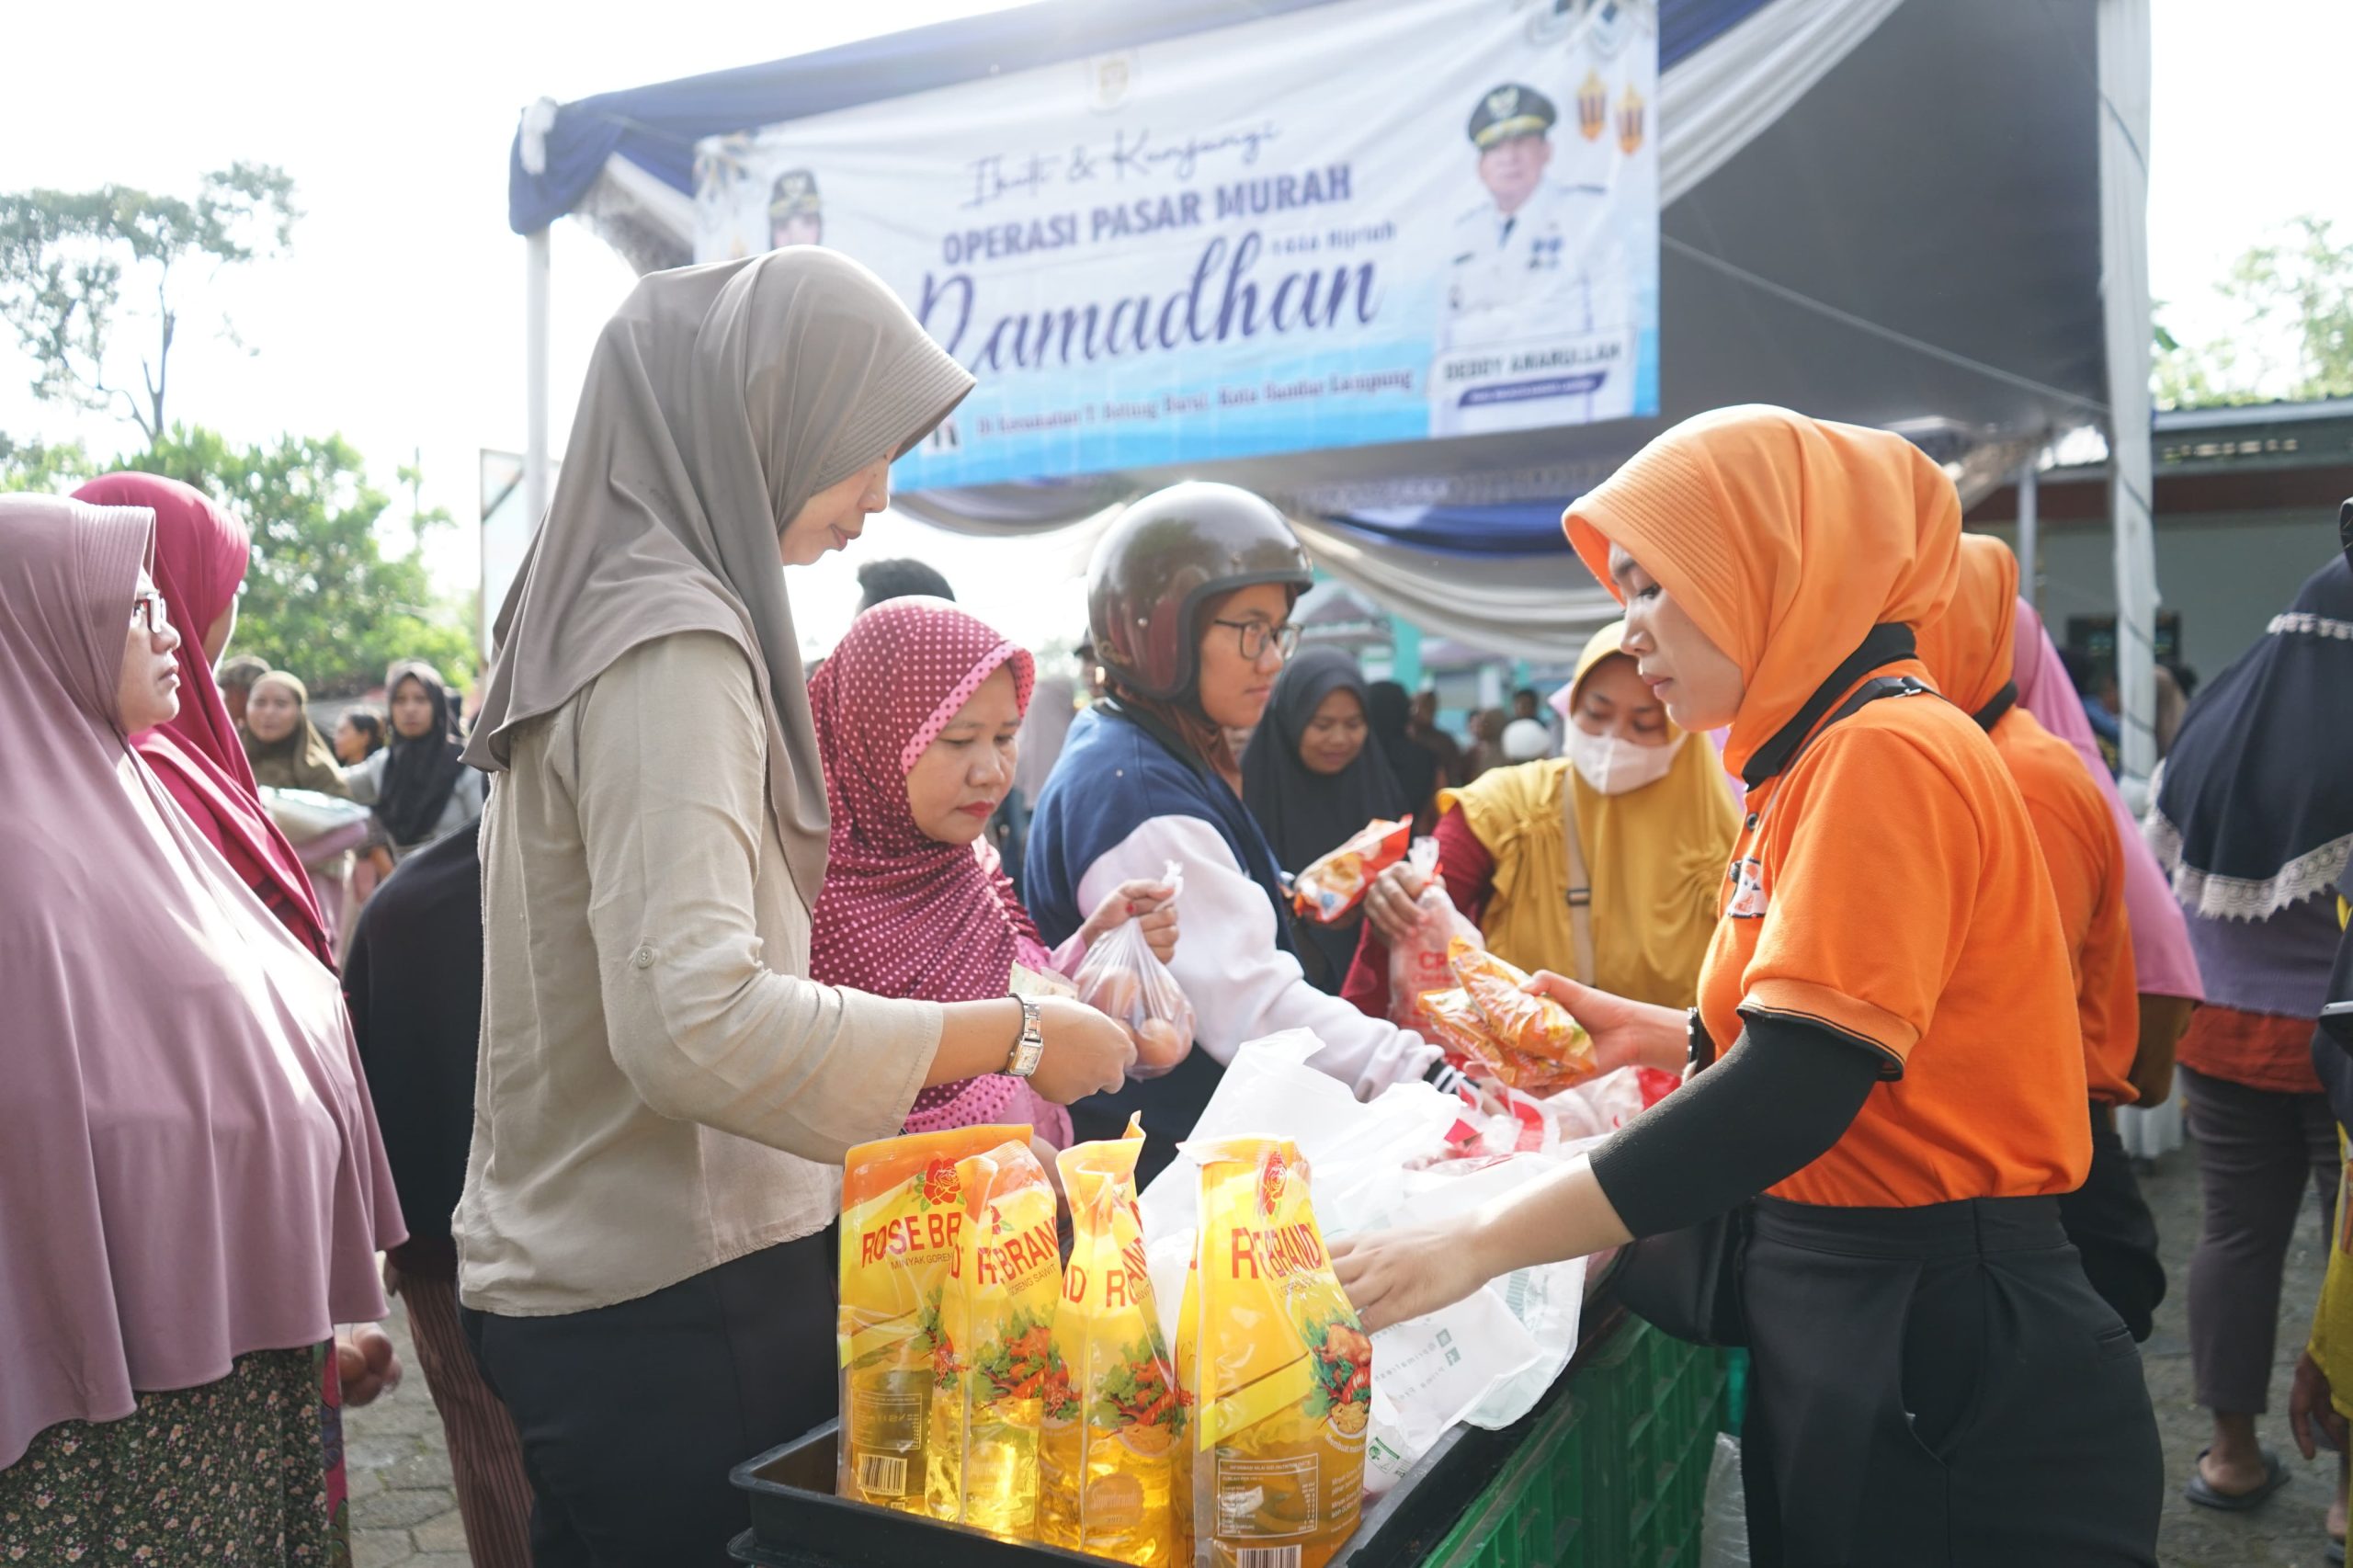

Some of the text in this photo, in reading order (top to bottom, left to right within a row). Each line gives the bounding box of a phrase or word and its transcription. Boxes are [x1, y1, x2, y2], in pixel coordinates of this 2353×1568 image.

[1067, 144, 1097, 183] &
[942, 163, 1353, 267] OPERASI PASAR MURAH
[922, 230, 1382, 375] Ramadhan
[862, 1215, 925, 1268] ROSE
[891, 1252, 955, 1271] MINYAK GOREN
[1034, 1263, 1057, 1282] SAWIT
